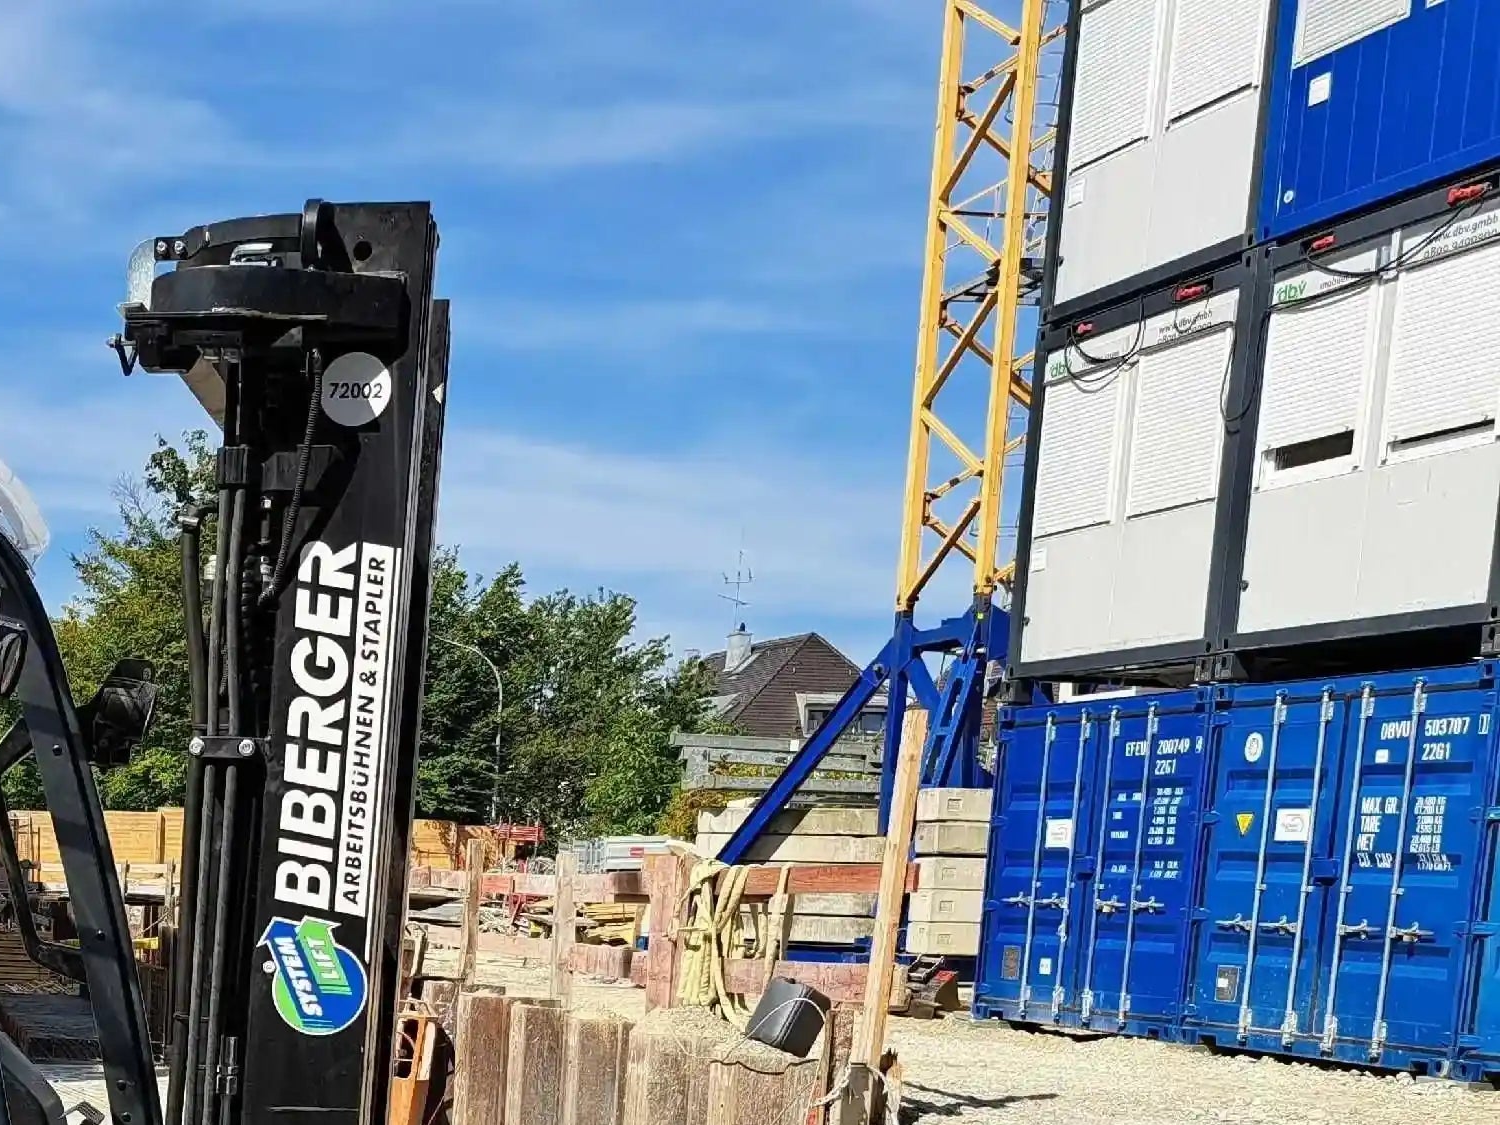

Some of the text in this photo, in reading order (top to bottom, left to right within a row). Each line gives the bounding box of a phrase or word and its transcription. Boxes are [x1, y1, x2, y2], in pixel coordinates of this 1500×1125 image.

[328, 382, 383, 399] 72002
[274, 541, 357, 909] BIBERGER
[342, 556, 386, 905] ARBEITSBÜHNEN & STAPLER
[1425, 717, 1470, 736] 503707
[1361, 816, 1382, 833] TARE
[1357, 834, 1376, 851] NET
[306, 936, 341, 980] LIFT
[274, 937, 323, 1017] SYSTEM
